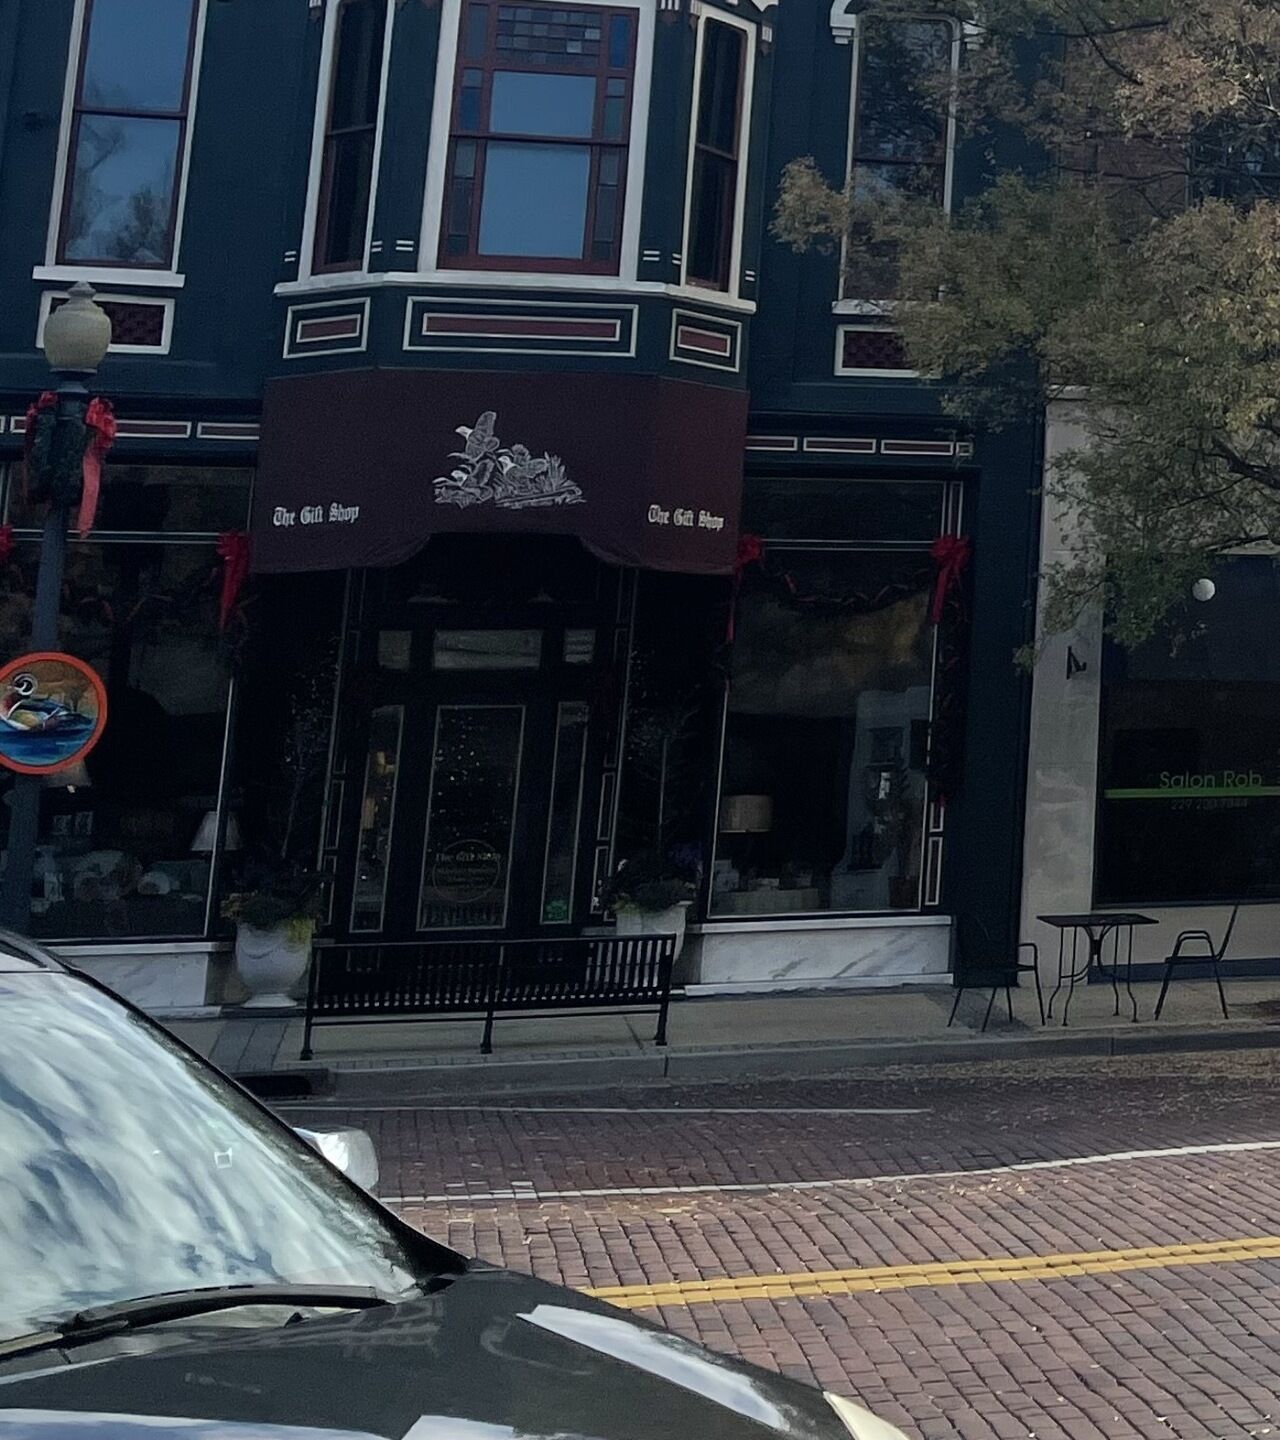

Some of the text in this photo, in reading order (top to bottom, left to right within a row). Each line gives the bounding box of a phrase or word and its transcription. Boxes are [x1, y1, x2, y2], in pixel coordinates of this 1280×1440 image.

[273, 502, 360, 528] The Gift Shop
[648, 504, 725, 532] The Gift Shop
[1159, 769, 1262, 789] Salon Rob
